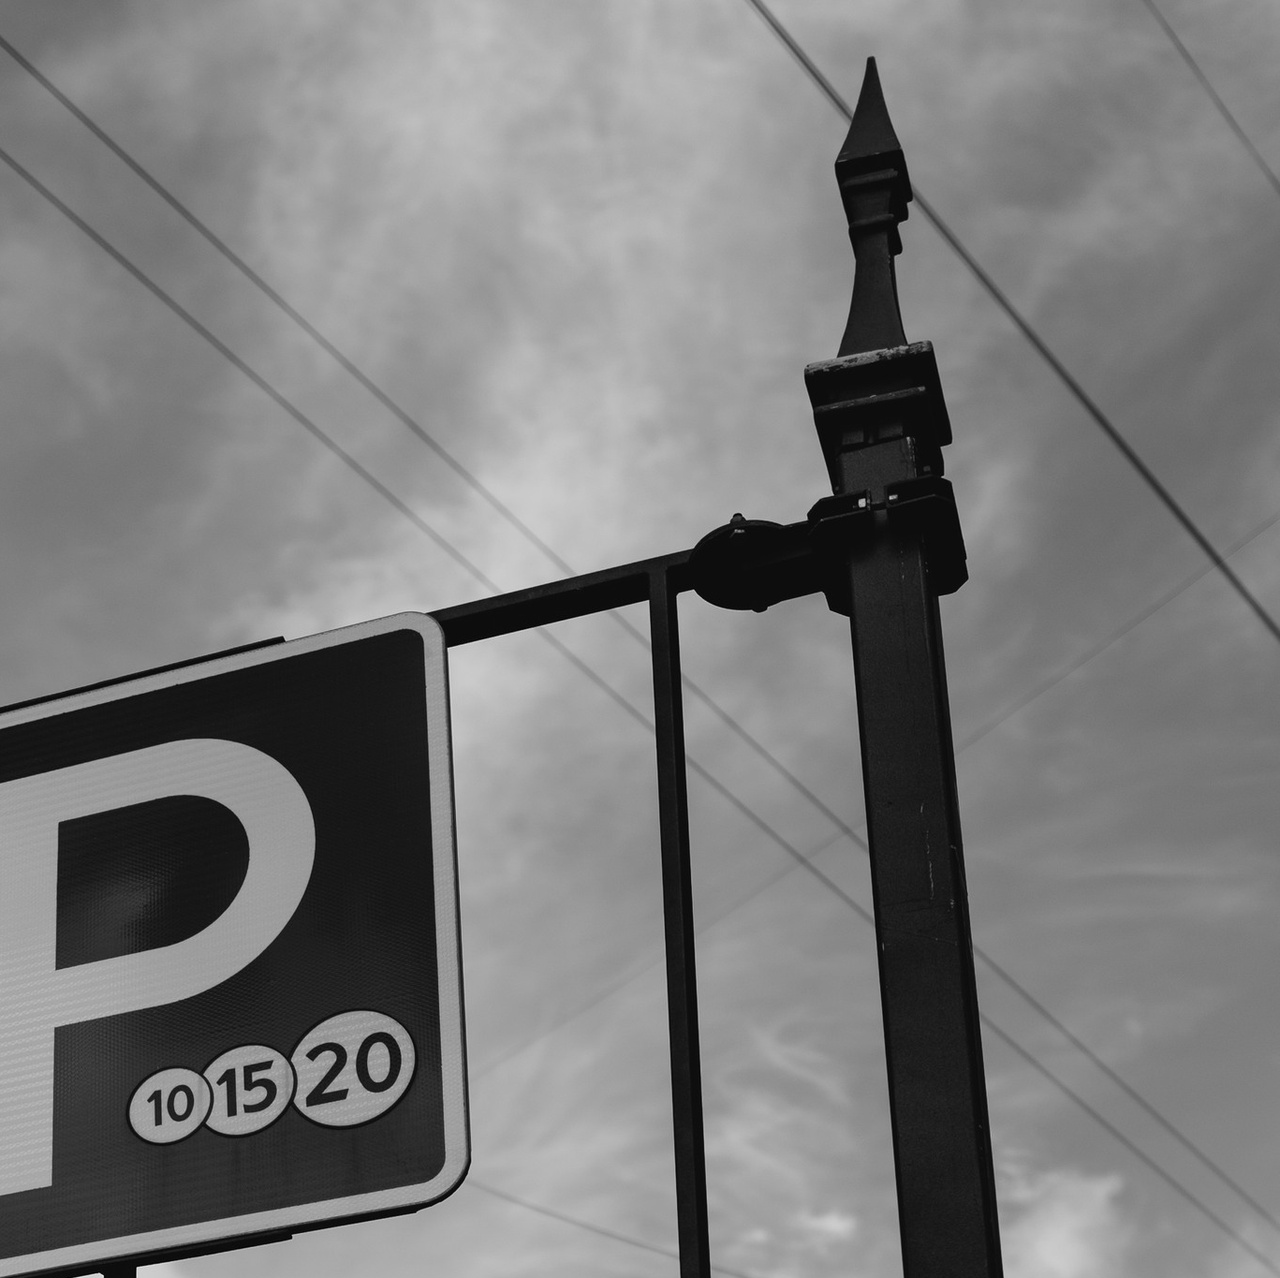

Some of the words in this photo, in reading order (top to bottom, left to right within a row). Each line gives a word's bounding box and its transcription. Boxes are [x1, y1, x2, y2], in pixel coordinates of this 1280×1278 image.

[147, 1083, 195, 1126] 10
[217, 1059, 278, 1118] 15
[305, 1031, 402, 1108] 20
